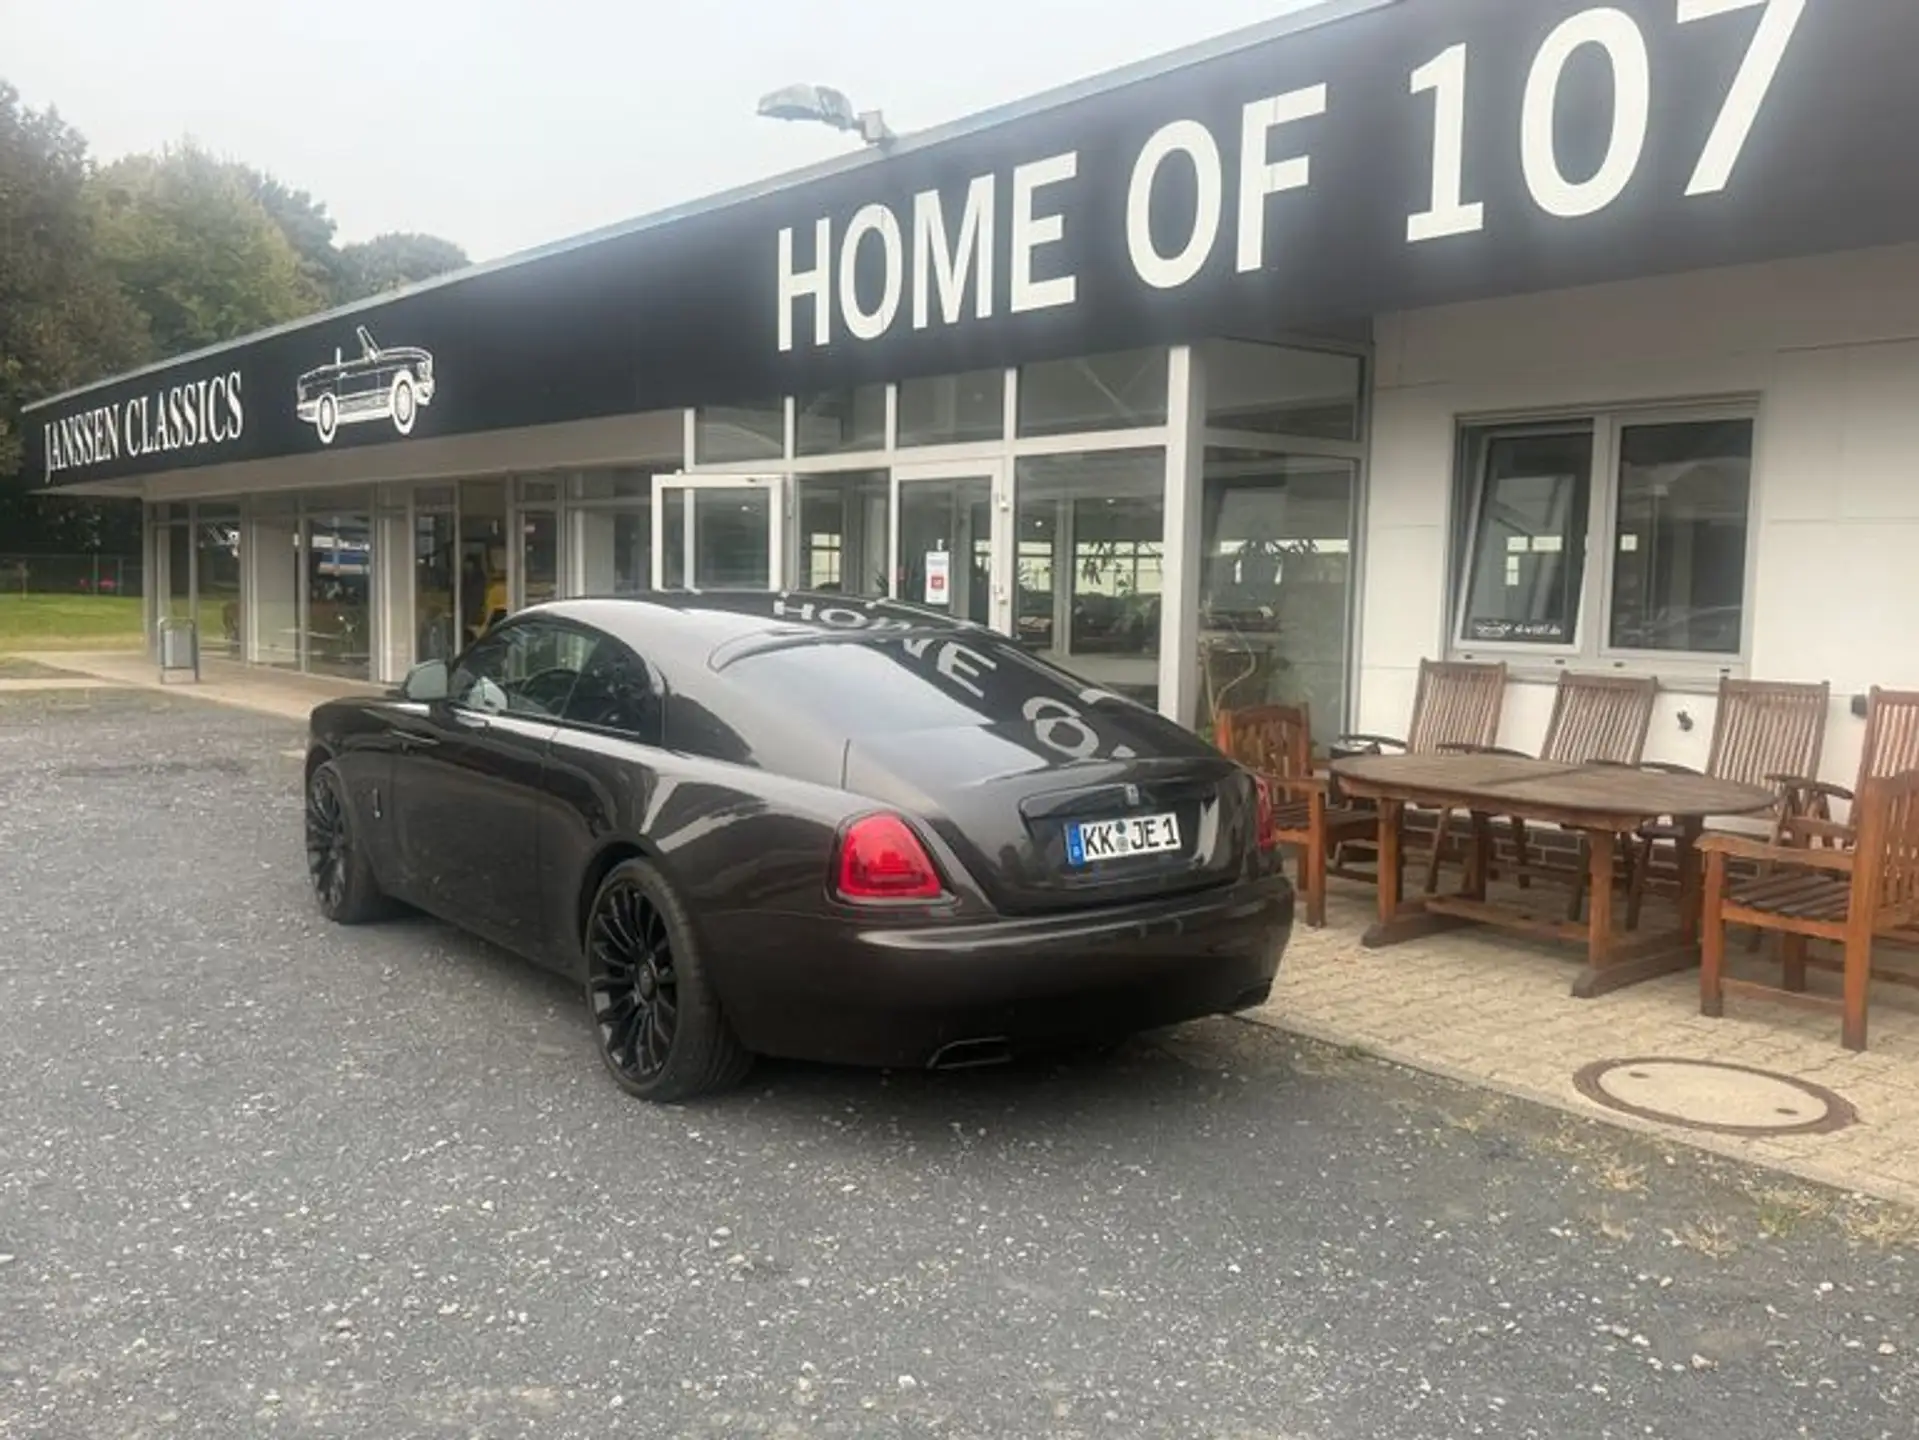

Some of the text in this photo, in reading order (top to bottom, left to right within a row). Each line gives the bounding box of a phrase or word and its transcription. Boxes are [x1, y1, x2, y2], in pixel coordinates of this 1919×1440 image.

[777, 0, 1804, 352] HOME OF 107
[44, 370, 244, 484] JANSSEN CLASSICS
